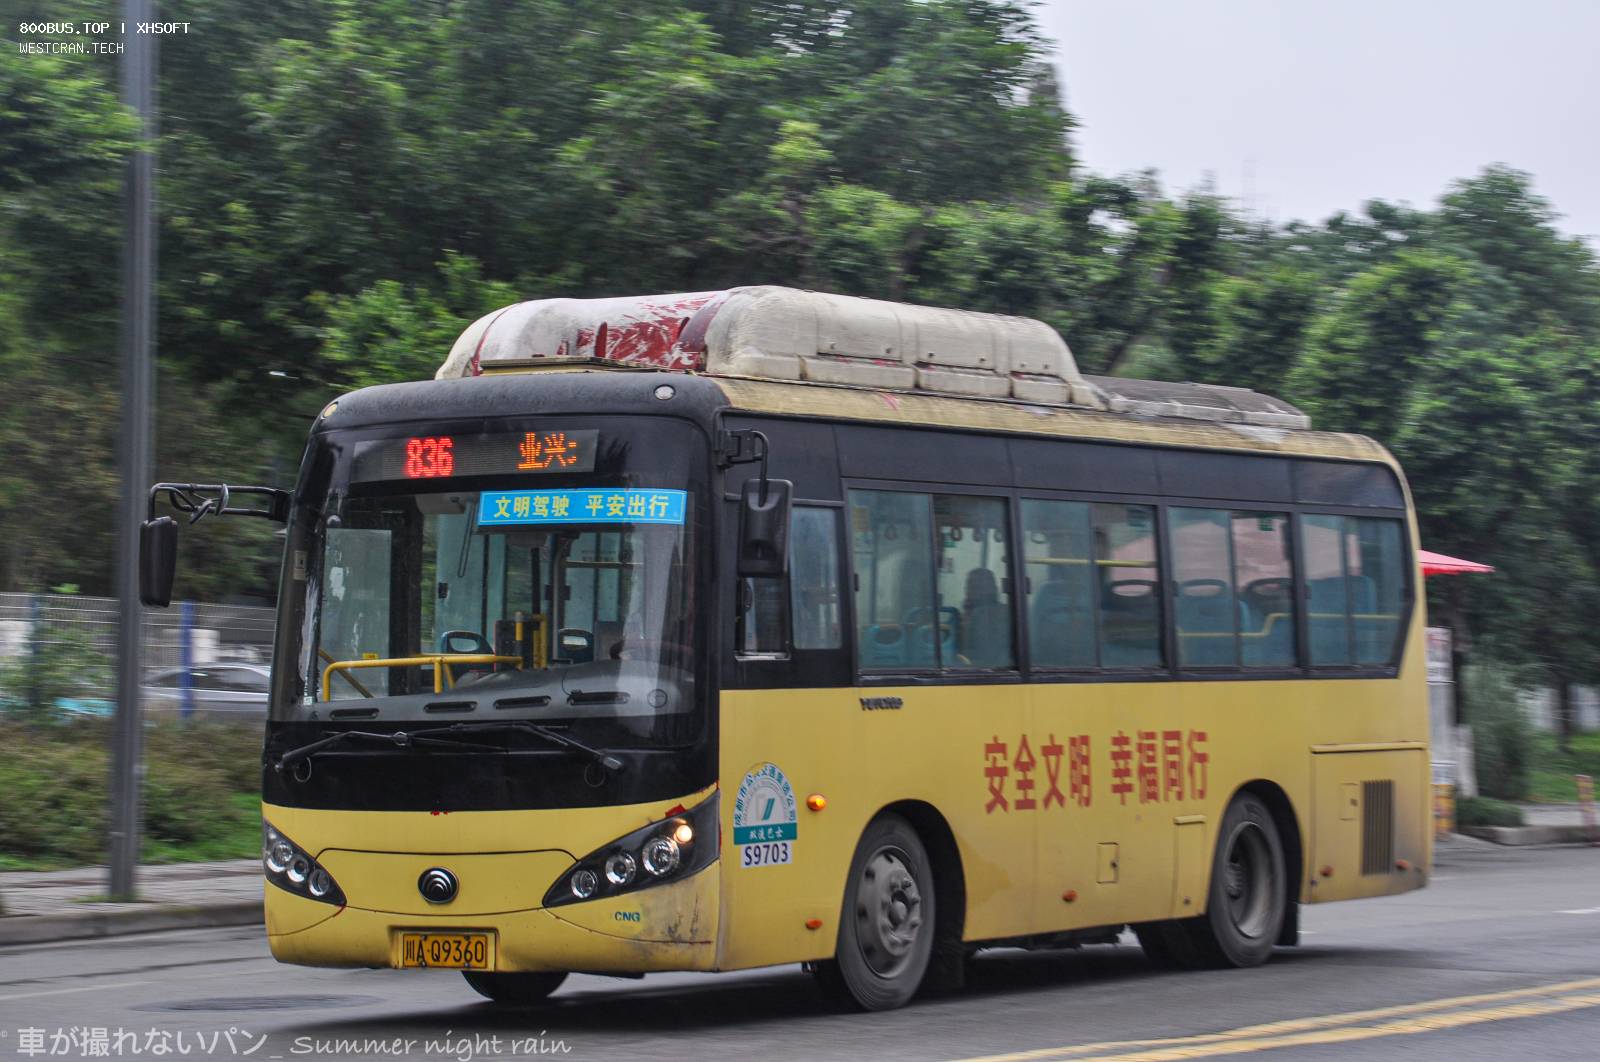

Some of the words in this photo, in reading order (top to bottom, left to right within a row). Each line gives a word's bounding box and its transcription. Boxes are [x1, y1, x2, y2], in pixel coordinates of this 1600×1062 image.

[406, 436, 454, 478] 836
[493, 495, 570, 519] 文明驾驶
[585, 493, 670, 518] 平安出行
[984, 734, 1093, 815] 安全文明
[1109, 730, 1210, 806] 幸福同行
[744, 842, 789, 866] S9703
[614, 911, 641, 922] CNG
